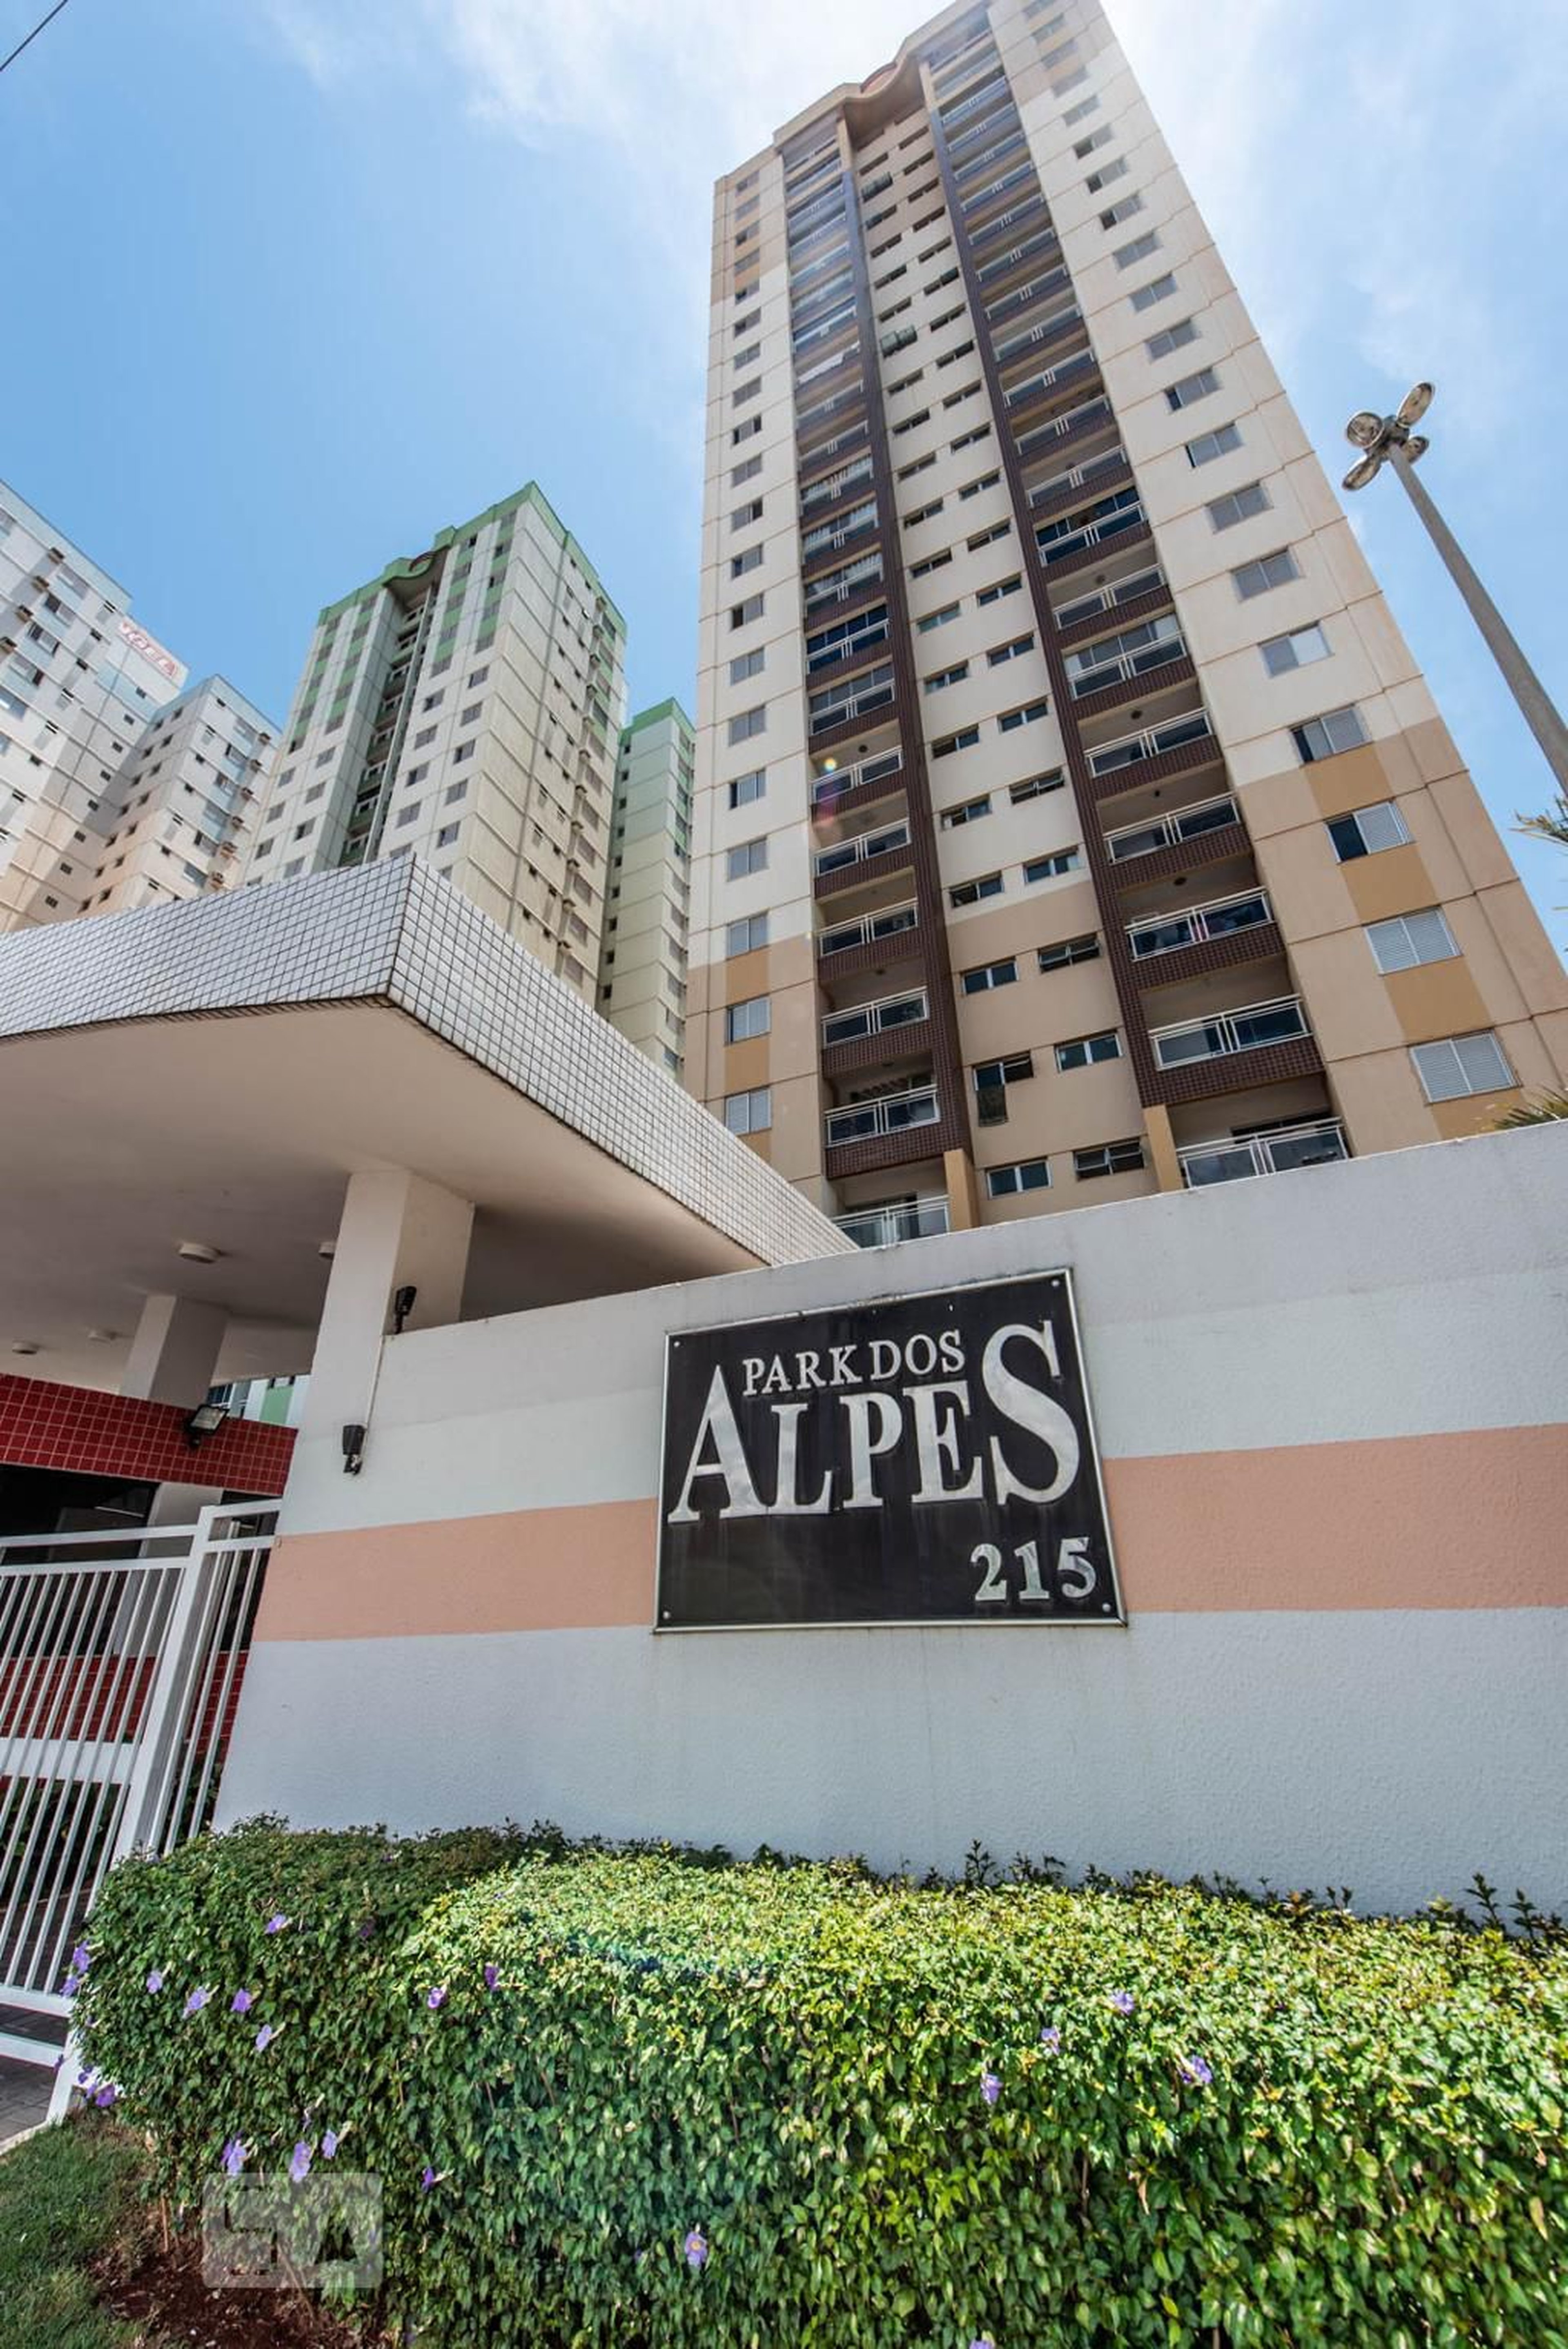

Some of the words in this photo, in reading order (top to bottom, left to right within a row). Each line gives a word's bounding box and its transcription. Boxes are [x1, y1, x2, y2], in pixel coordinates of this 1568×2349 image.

[742, 1345, 863, 1396] PARK
[869, 1329, 965, 1380] DOS
[667, 1320, 1080, 1523] ALPES
[970, 1536, 1096, 1601] 215
